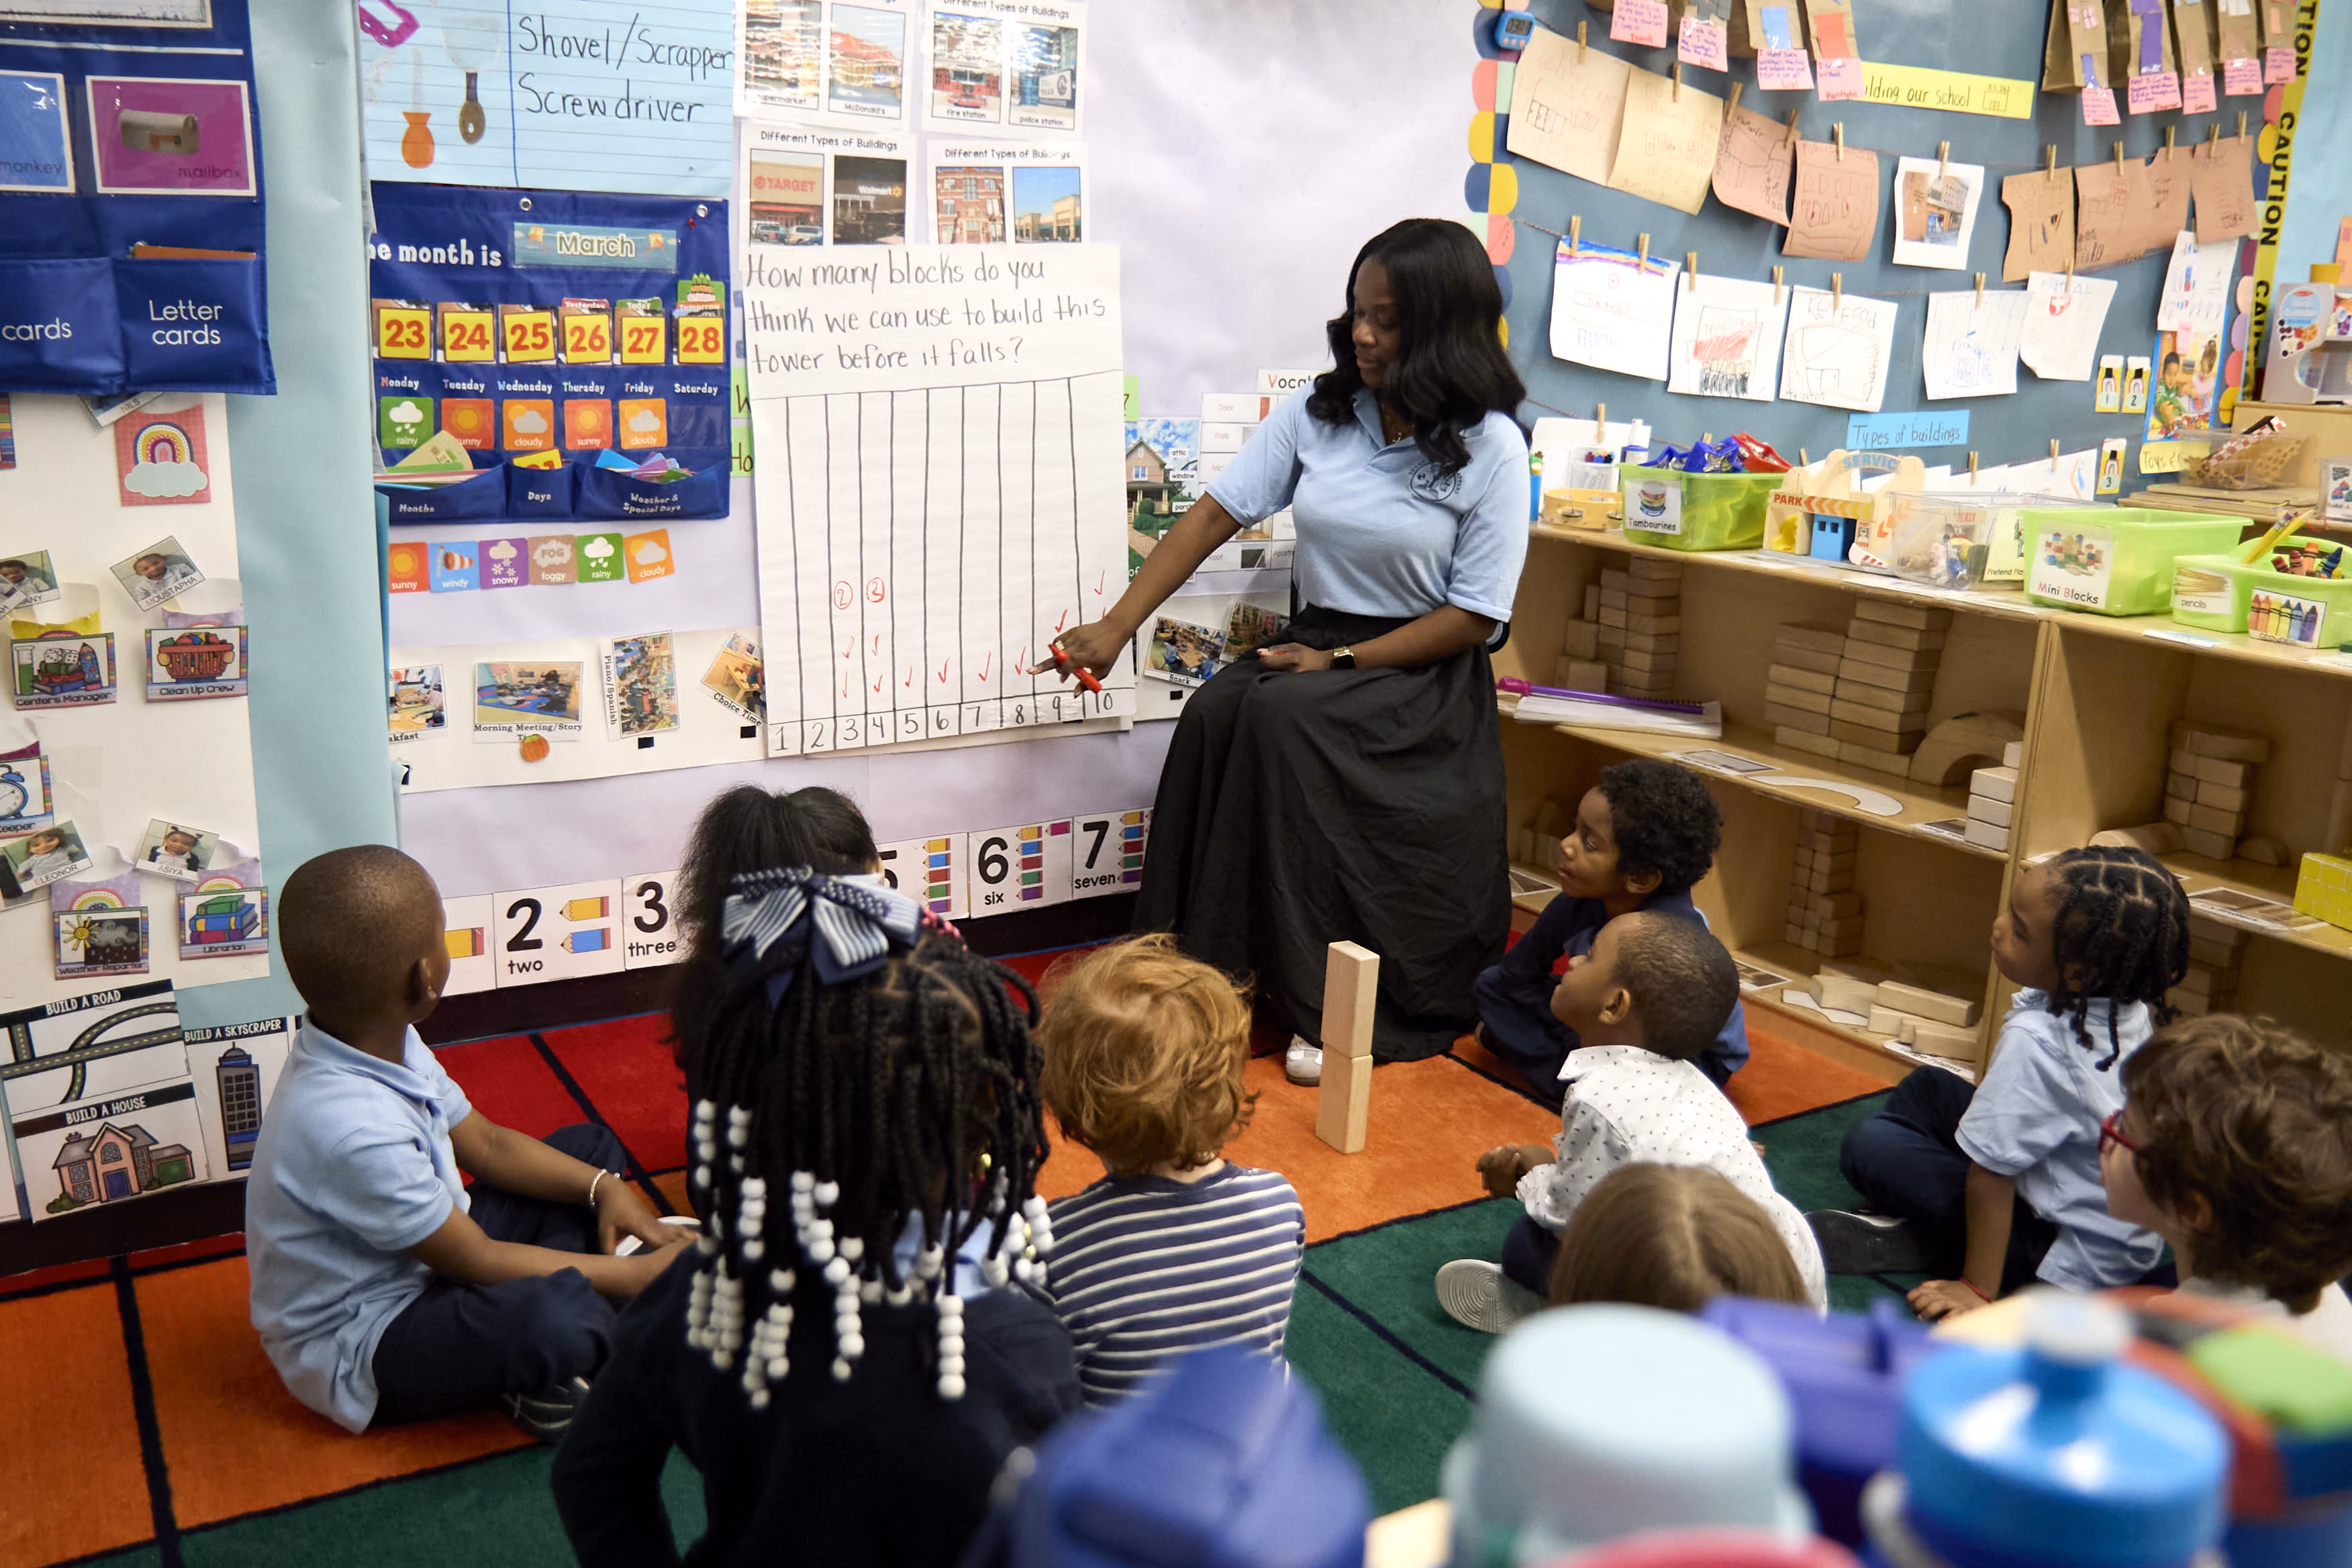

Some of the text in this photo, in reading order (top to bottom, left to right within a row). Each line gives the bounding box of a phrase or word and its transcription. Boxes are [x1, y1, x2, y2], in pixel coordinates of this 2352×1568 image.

[990, 1, 1069, 19] Types of Buildings
[519, 13, 734, 81] Shovel/Scrapper
[2294, 1, 2317, 77] TION
[1907, 85, 1971, 107] our school
[844, 103, 885, 115] McDonald's
[963, 111, 986, 119] station
[1041, 117, 1063, 126] station
[761, 130, 897, 151] Different Types of Buildings
[945, 149, 1030, 159] Different Types of
[0, 160, 62, 177] monkey
[178, 165, 242, 180] mailbox
[767, 177, 816, 193] TARGET
[2260, 111, 2295, 246] CAUTION
[858, 185, 892, 195] Walmart
[399, 239, 502, 267] month is
[556, 232, 636, 258] March
[746, 249, 1046, 294] How many blocks do you
[149, 299, 223, 322] Letter
[626, 301, 651, 310] Today
[748, 293, 1106, 334] think we can use to build this
[1, 317, 72, 341] cards
[152, 324, 222, 346] cards
[385, 319, 721, 354] 23 24 25 26 27 28
[752, 336, 1024, 374] tower before it falls?
[381, 377, 718, 396] Monday Tuesday Wednesday Thursday Friday Saturday
[2132, 394, 2137, 406] 2
[396, 436, 418, 448] rainy
[514, 437, 543, 448] cloudy
[577, 438, 601, 448] sunny
[630, 435, 658, 446] cloudy
[1214, 432, 1230, 440] Walls
[1853, 420, 1960, 446] Types of buildings
[2142, 450, 2166, 471] Toys
[1171, 472, 1195, 480] window
[2106, 476, 2112, 488] 3
[527, 491, 552, 503] Days
[630, 493, 679, 505] Weather &
[1773, 493, 1802, 507] PARK
[399, 503, 435, 515] Months
[622, 503, 681, 515] Special Days
[1628, 518, 1677, 532] Tambourines
[541, 548, 565, 559] FOG
[391, 566, 667, 591] sunny windy snowy foggy rainy cloudy
[1987, 568, 2012, 576] Pretend
[144, 575, 198, 607] MOUSTAPHA
[2038, 582, 2099, 604] Mini Blocks
[2181, 599, 2207, 609] pencils
[1169, 674, 1191, 685] Snack
[159, 683, 235, 696] Clean Up Crew
[604, 654, 617, 726] Piano/Spanish
[16, 691, 113, 707] Centers Manager
[713, 691, 762, 727] Choice Time
[474, 722, 583, 733] Morning Meeting/Story
[774, 690, 1114, 751] 1 2 3 4 5 6 7 8 9 10
[1081, 820, 1111, 871] 7
[157, 863, 183, 877] ASIYA
[977, 837, 1009, 885] 6
[34, 863, 79, 887] ELEONOR
[1073, 872, 1118, 889] seven
[984, 889, 1004, 906] six
[633, 880, 668, 934] 3
[505, 897, 544, 952] 2
[203, 942, 246, 954] Librarian
[627, 938, 676, 959] three
[58, 964, 100, 976] Weather
[507, 957, 544, 975] two
[46, 990, 121, 1016] BUILD A ROAD
[184, 1019, 282, 1043] BUILD A SKYSCRAPER
[66, 1096, 146, 1125] BUILD A HOUSE
